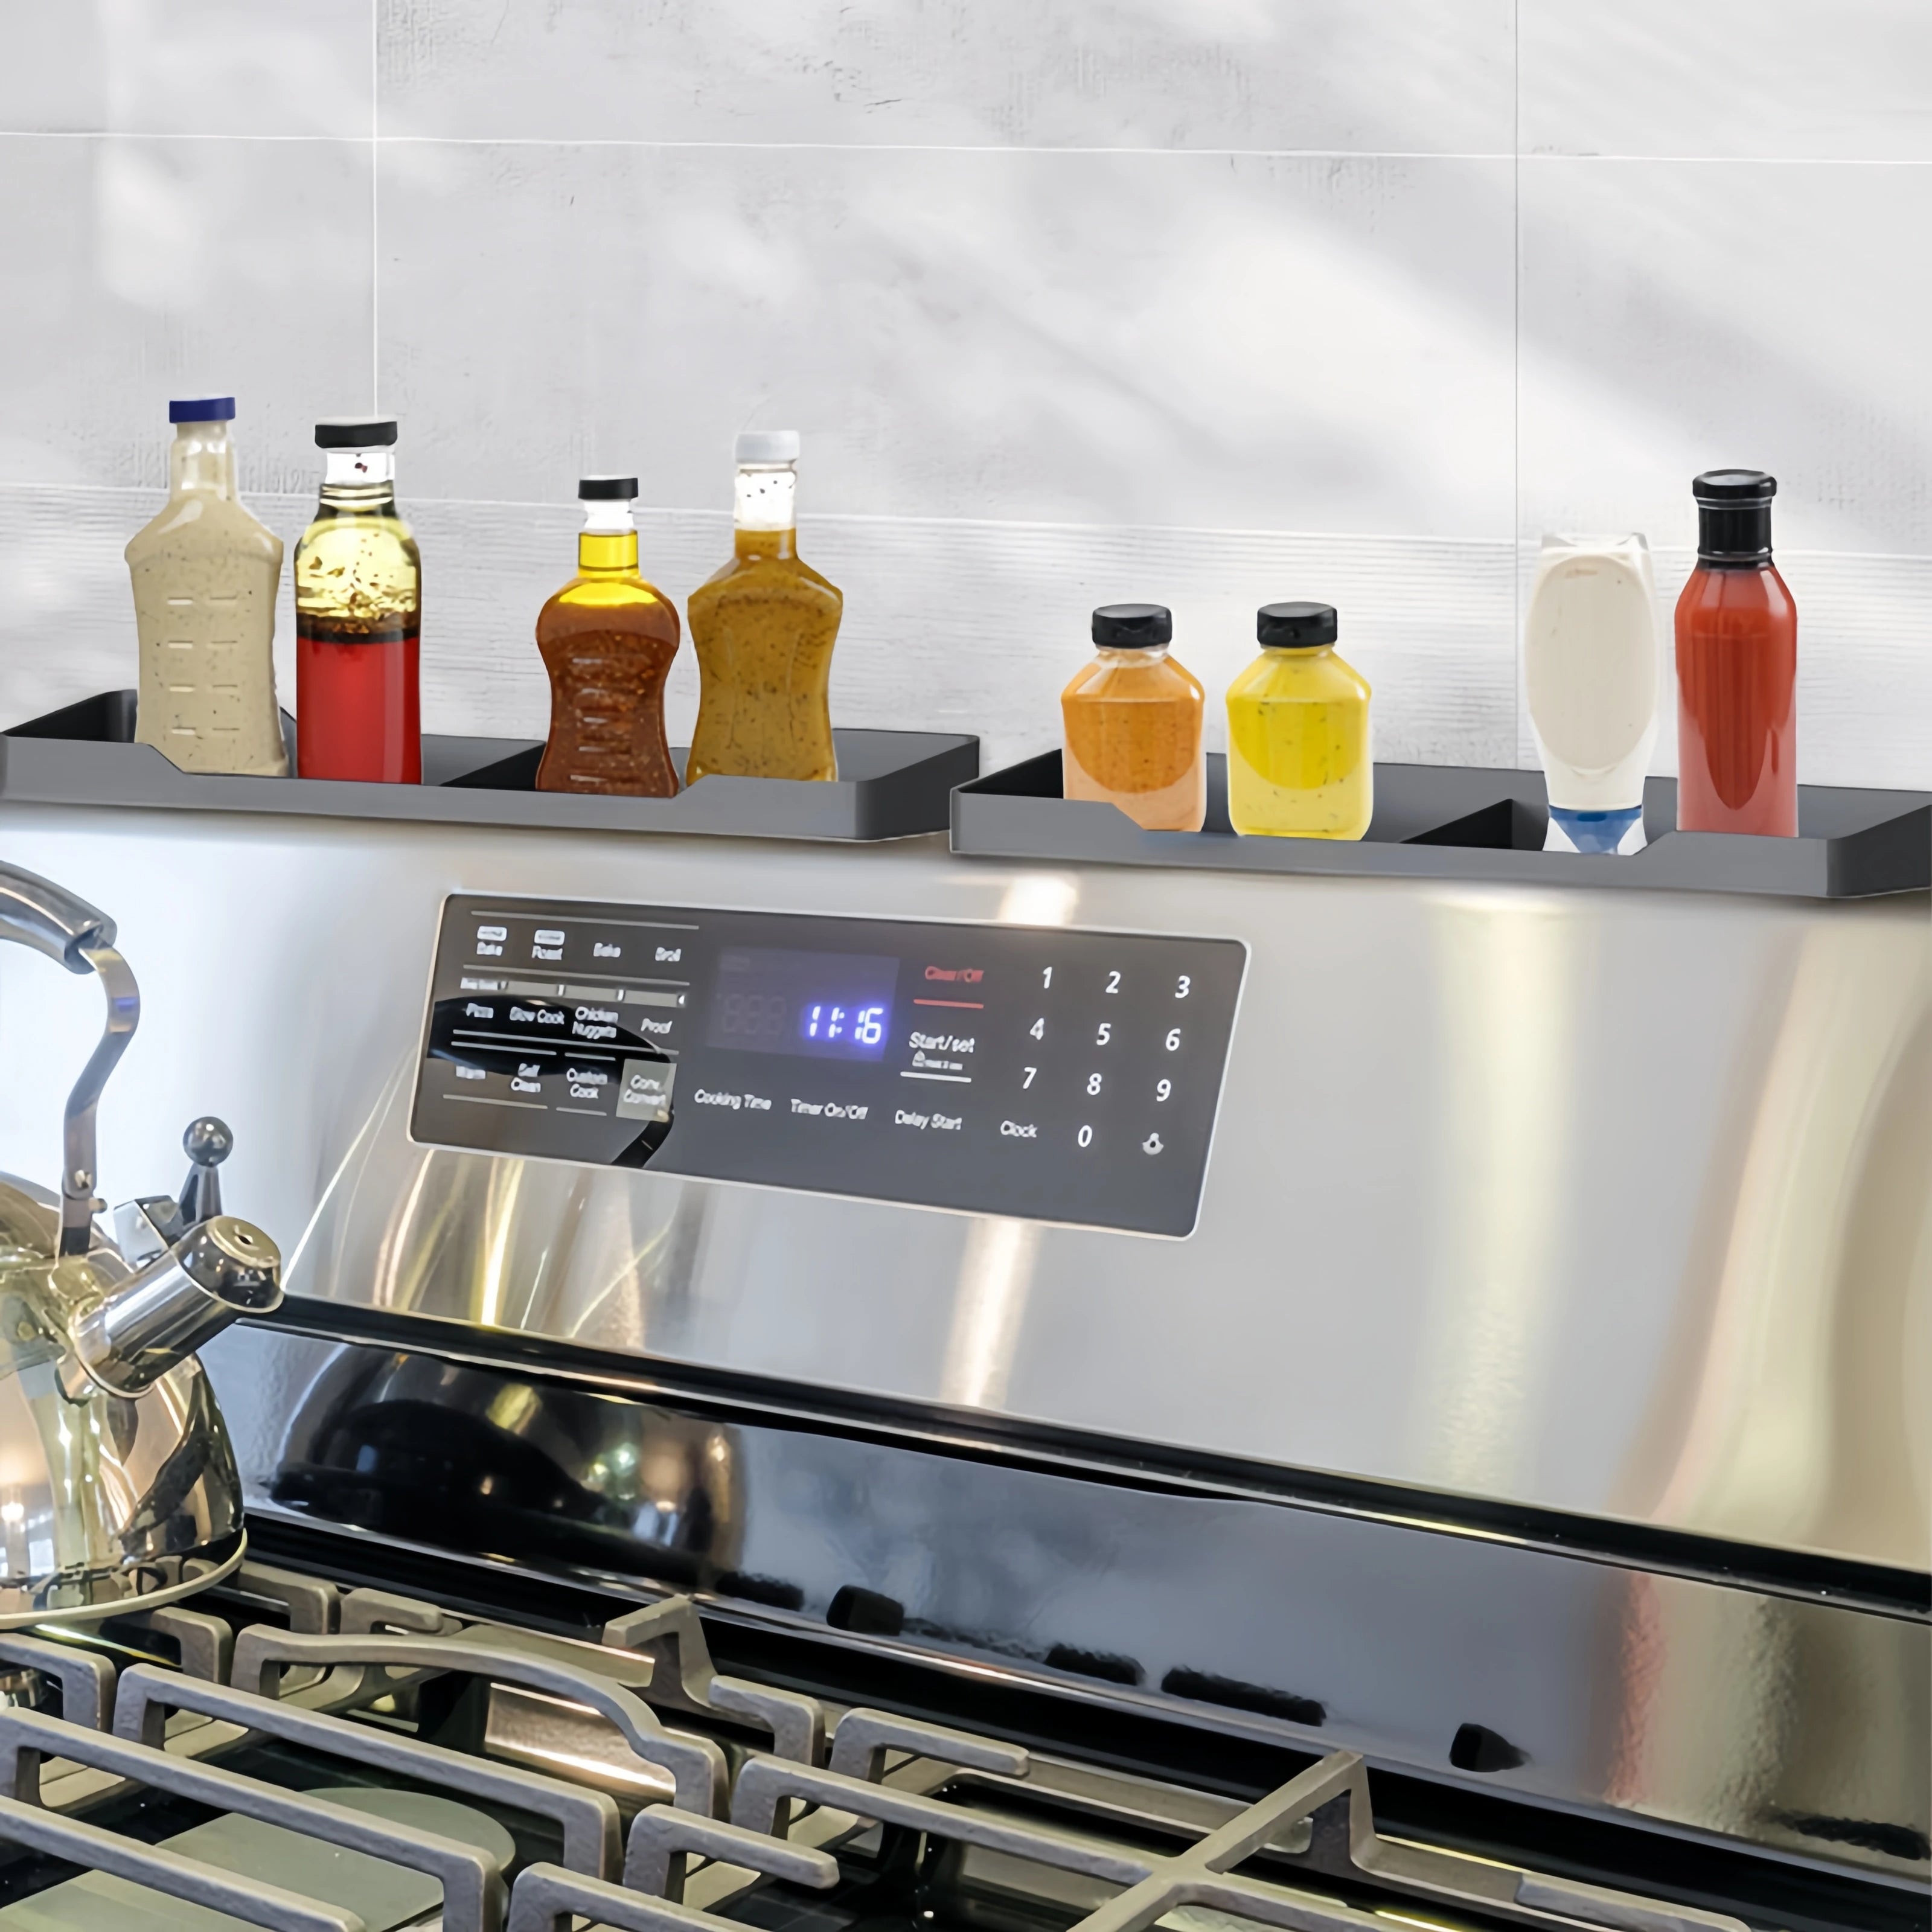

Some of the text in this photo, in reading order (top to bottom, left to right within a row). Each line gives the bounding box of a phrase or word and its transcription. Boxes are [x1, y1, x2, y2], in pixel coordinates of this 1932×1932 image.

[1043, 966, 1052, 989] 1
[1105, 970, 1121, 994] 2
[1174, 975, 1191, 999] 3
[808, 1005, 884, 1044] 11:16
[1029, 1017, 1044, 1040] 4
[1096, 1023, 1112, 1046] 5
[1165, 1028, 1181, 1051] 6
[1022, 1066, 1037, 1089] 7
[1086, 1072, 1102, 1095] 8
[1156, 1078, 1171, 1102] 9
[1078, 1125, 1093, 1148] 0
